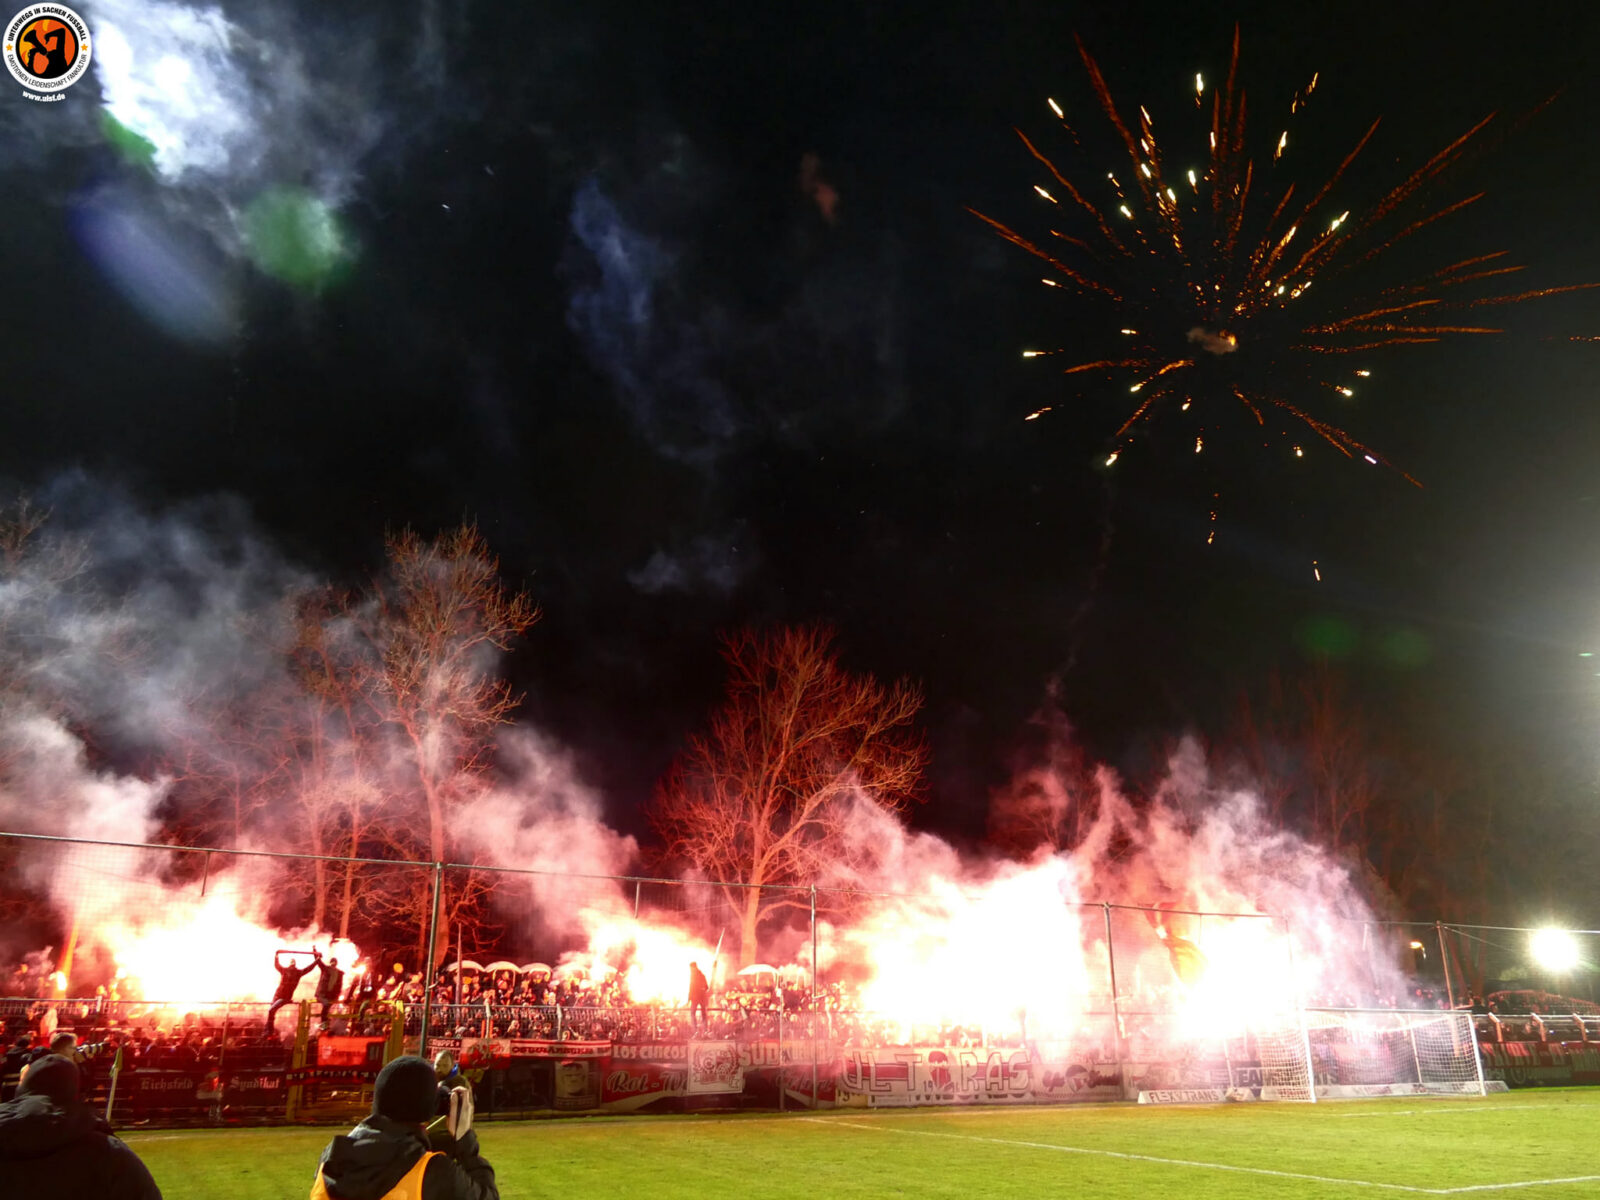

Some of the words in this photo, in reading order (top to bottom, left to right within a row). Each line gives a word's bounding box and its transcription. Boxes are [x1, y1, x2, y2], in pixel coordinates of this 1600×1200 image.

[613, 1045, 637, 1059] LOS
[141, 1077, 193, 1092] Eichsfeld
[229, 1076, 280, 1091] Syndikat
[1183, 1088, 1220, 1102] TRANS
